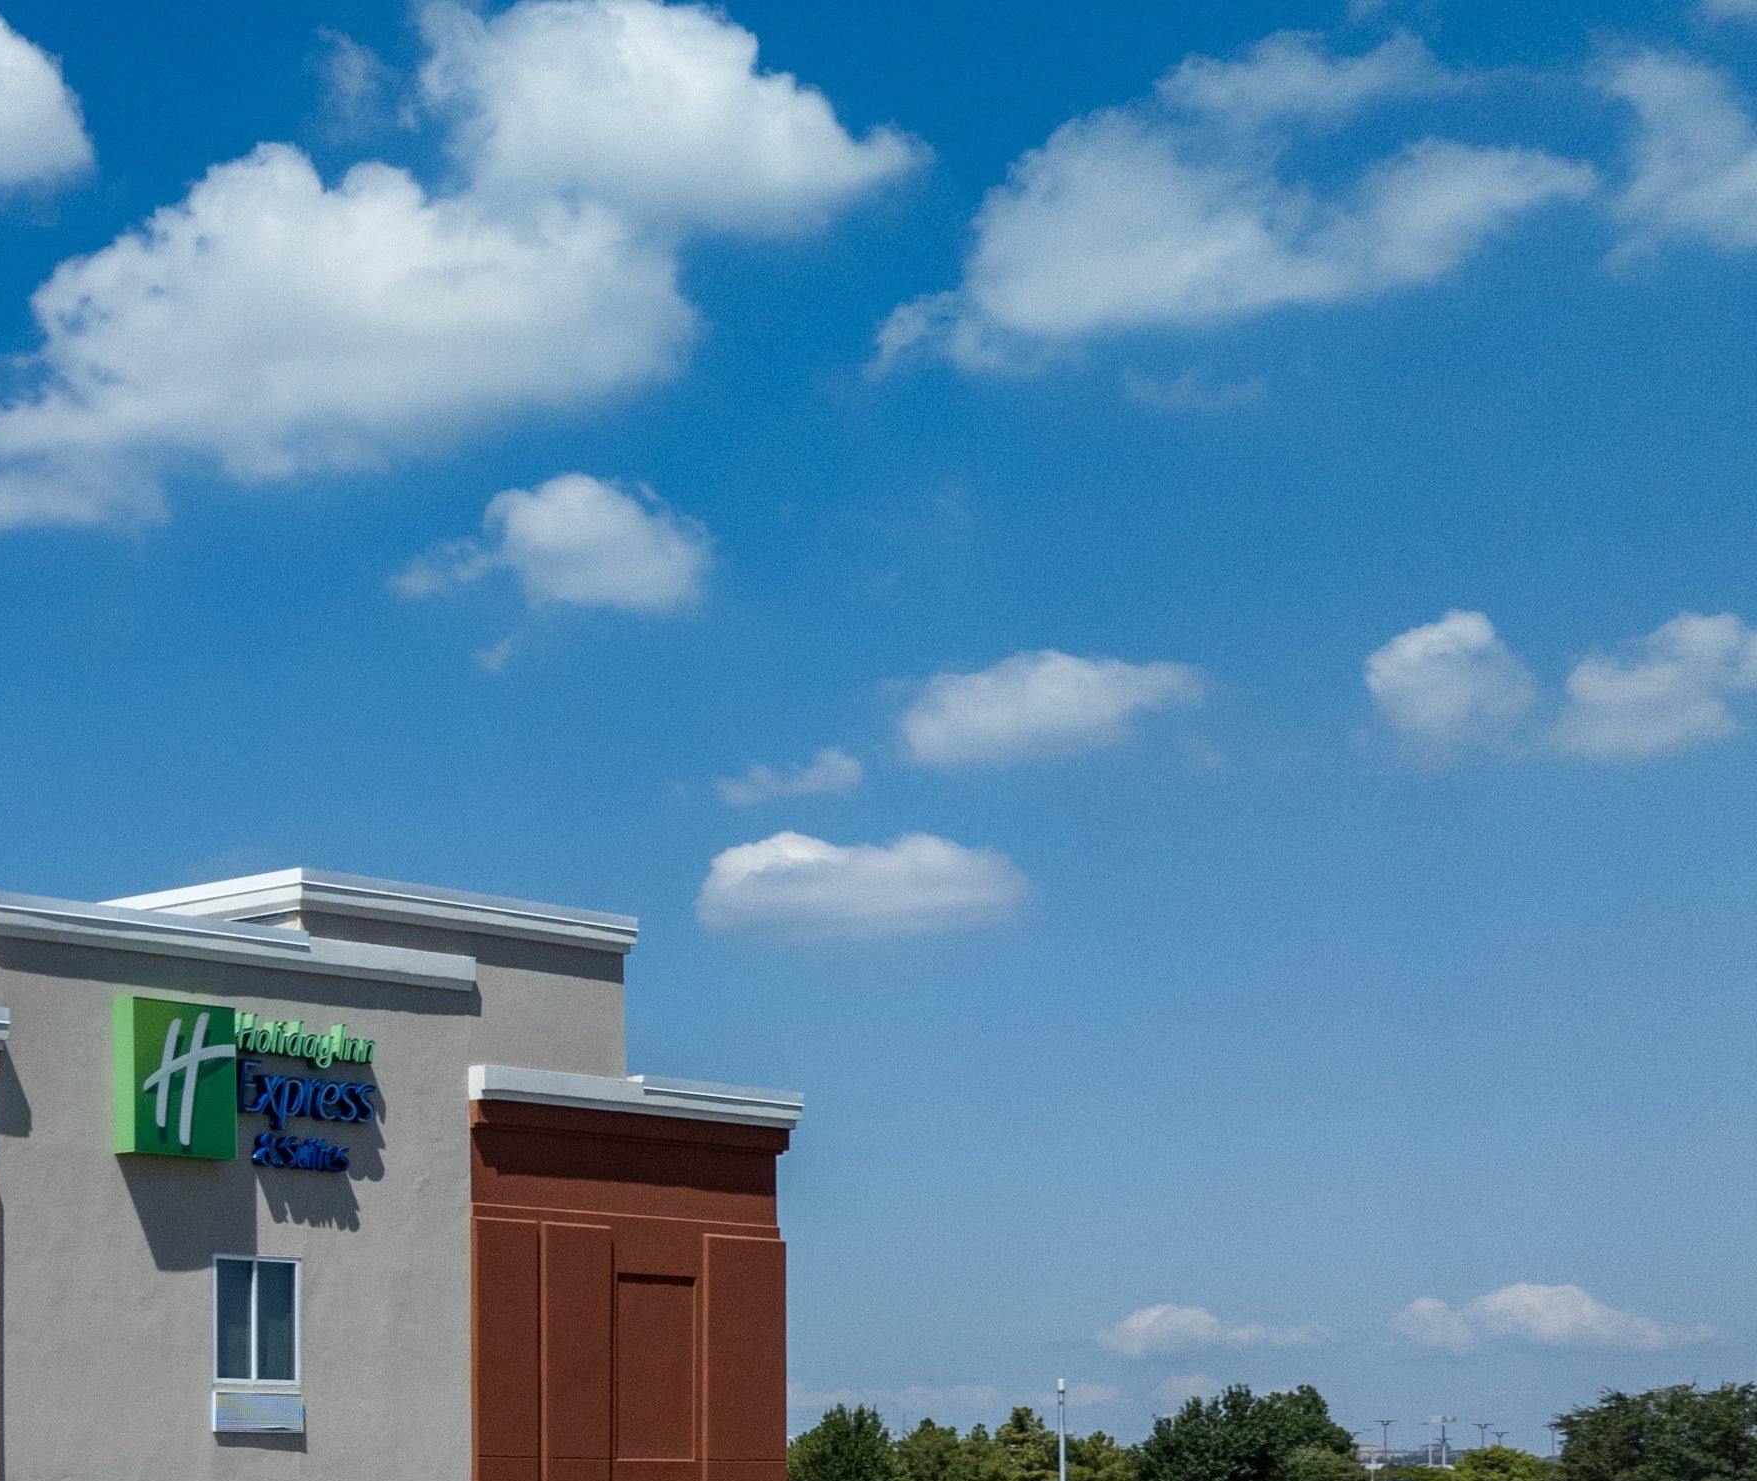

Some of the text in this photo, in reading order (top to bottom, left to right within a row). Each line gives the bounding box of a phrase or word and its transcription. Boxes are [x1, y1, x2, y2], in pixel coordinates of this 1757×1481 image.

[235, 1013, 377, 1068] Holiday Inn
[237, 1058, 377, 1130] Express
[278, 1136, 350, 1172] Suites
